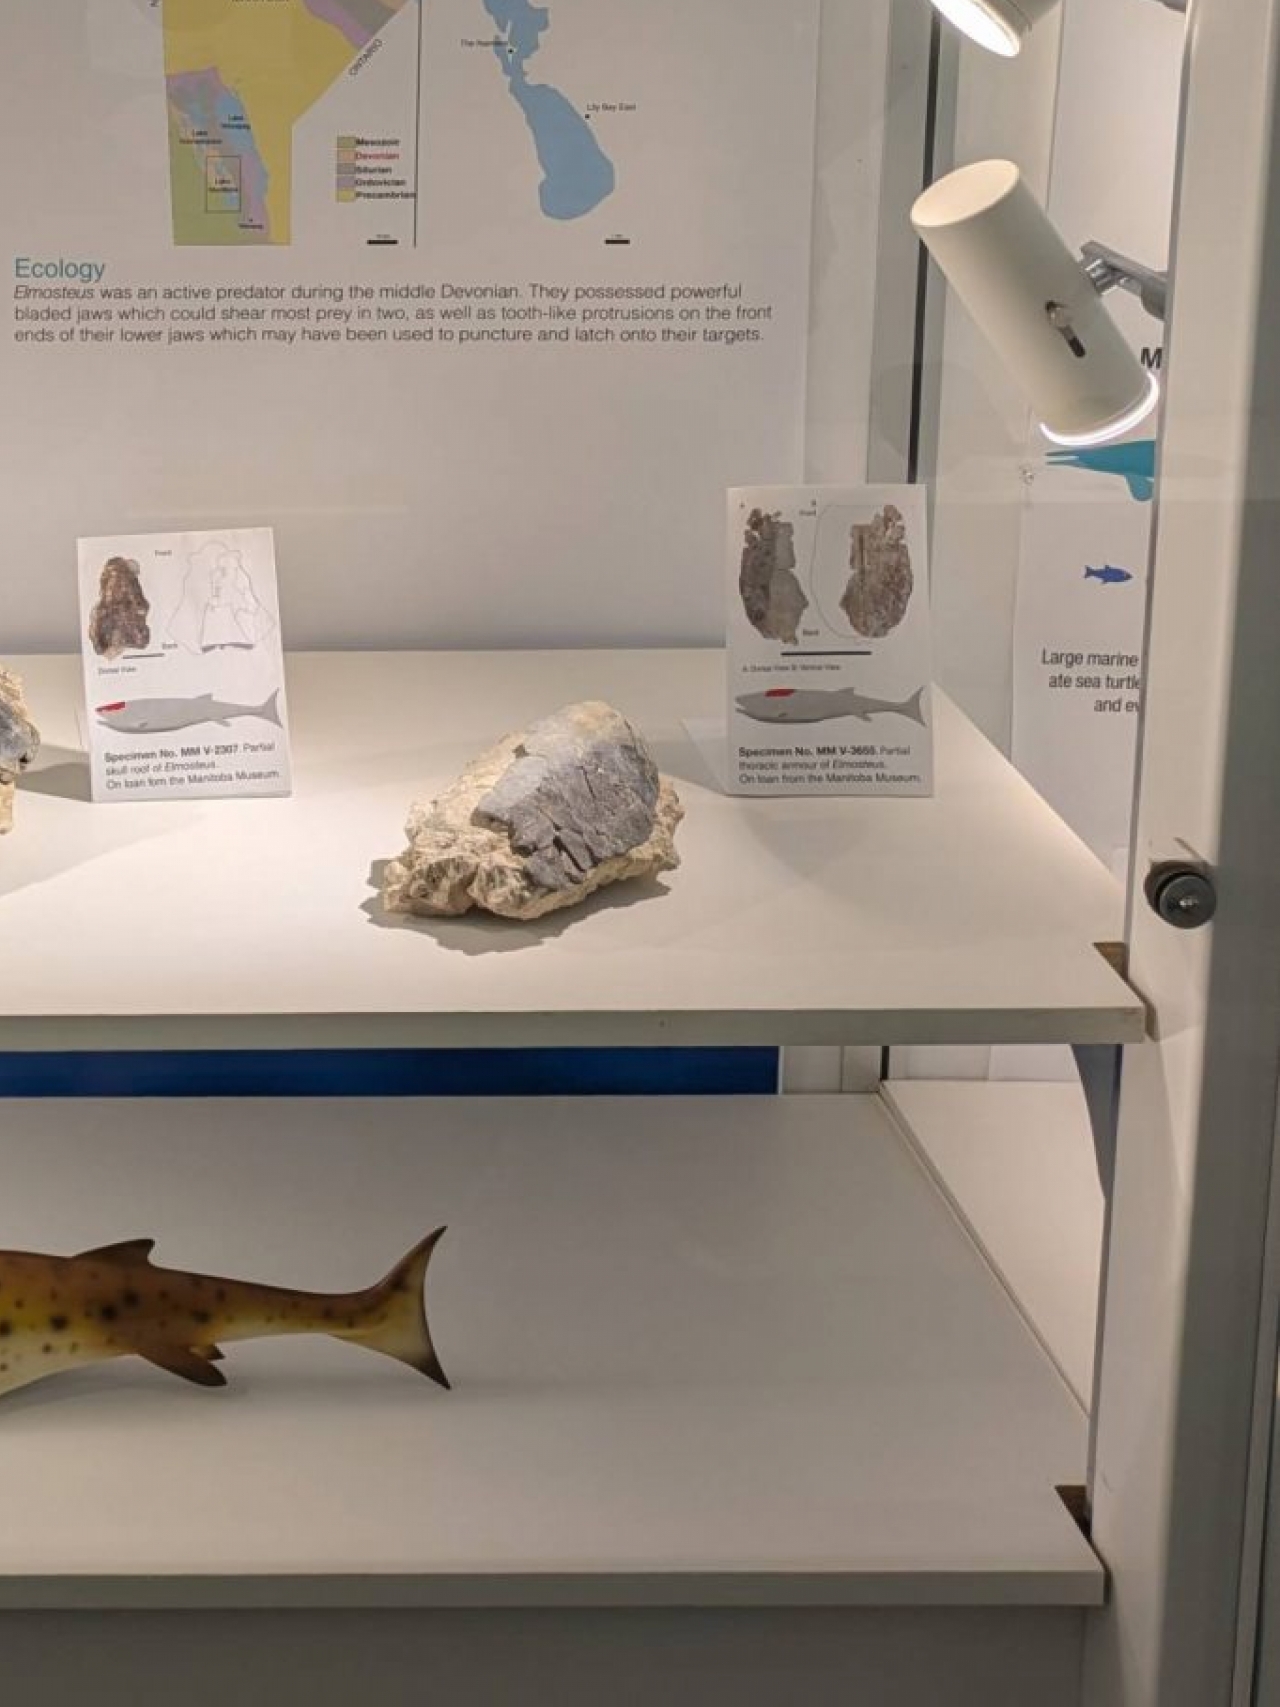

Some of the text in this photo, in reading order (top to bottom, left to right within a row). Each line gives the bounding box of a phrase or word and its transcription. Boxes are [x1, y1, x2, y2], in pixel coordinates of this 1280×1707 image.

[15, 258, 105, 282] Ecology
[14, 285, 94, 300] Elmosteus
[100, 288, 132, 300] was
[138, 288, 158, 299] an
[163, 285, 212, 299] active
[216, 284, 286, 302] predator
[292, 284, 343, 302] during
[348, 284, 373, 299] the
[381, 284, 436, 299] middle
[528, 282, 568, 301] They
[574, 285, 664, 302] possessed
[670, 282, 742, 300] powerful
[15, 304, 771, 324] bladed jaws which could shear most prey in two, as well as tooth-like protrusions on the front
[15, 327, 764, 344] ends of their lower jaws which may have been used to puncture and latch onto their targets.
[1041, 648, 1139, 668] Large marine
[1049, 674, 1072, 688] ate
[1076, 676, 1100, 688] sea
[1094, 698, 1122, 712] and
[104, 752, 157, 762] Specimen
[160, 749, 178, 758] No.
[181, 747, 200, 757] MM
[243, 742, 276, 752] Partial
[738, 747, 792, 758] Specimen
[796, 746, 812, 756] No.
[816, 746, 836, 755] MM
[739, 774, 754, 784] On
[758, 774, 779, 784] loan
[782, 773, 805, 783] from
[808, 773, 822, 783] the
[826, 772, 872, 783] Manitoba
